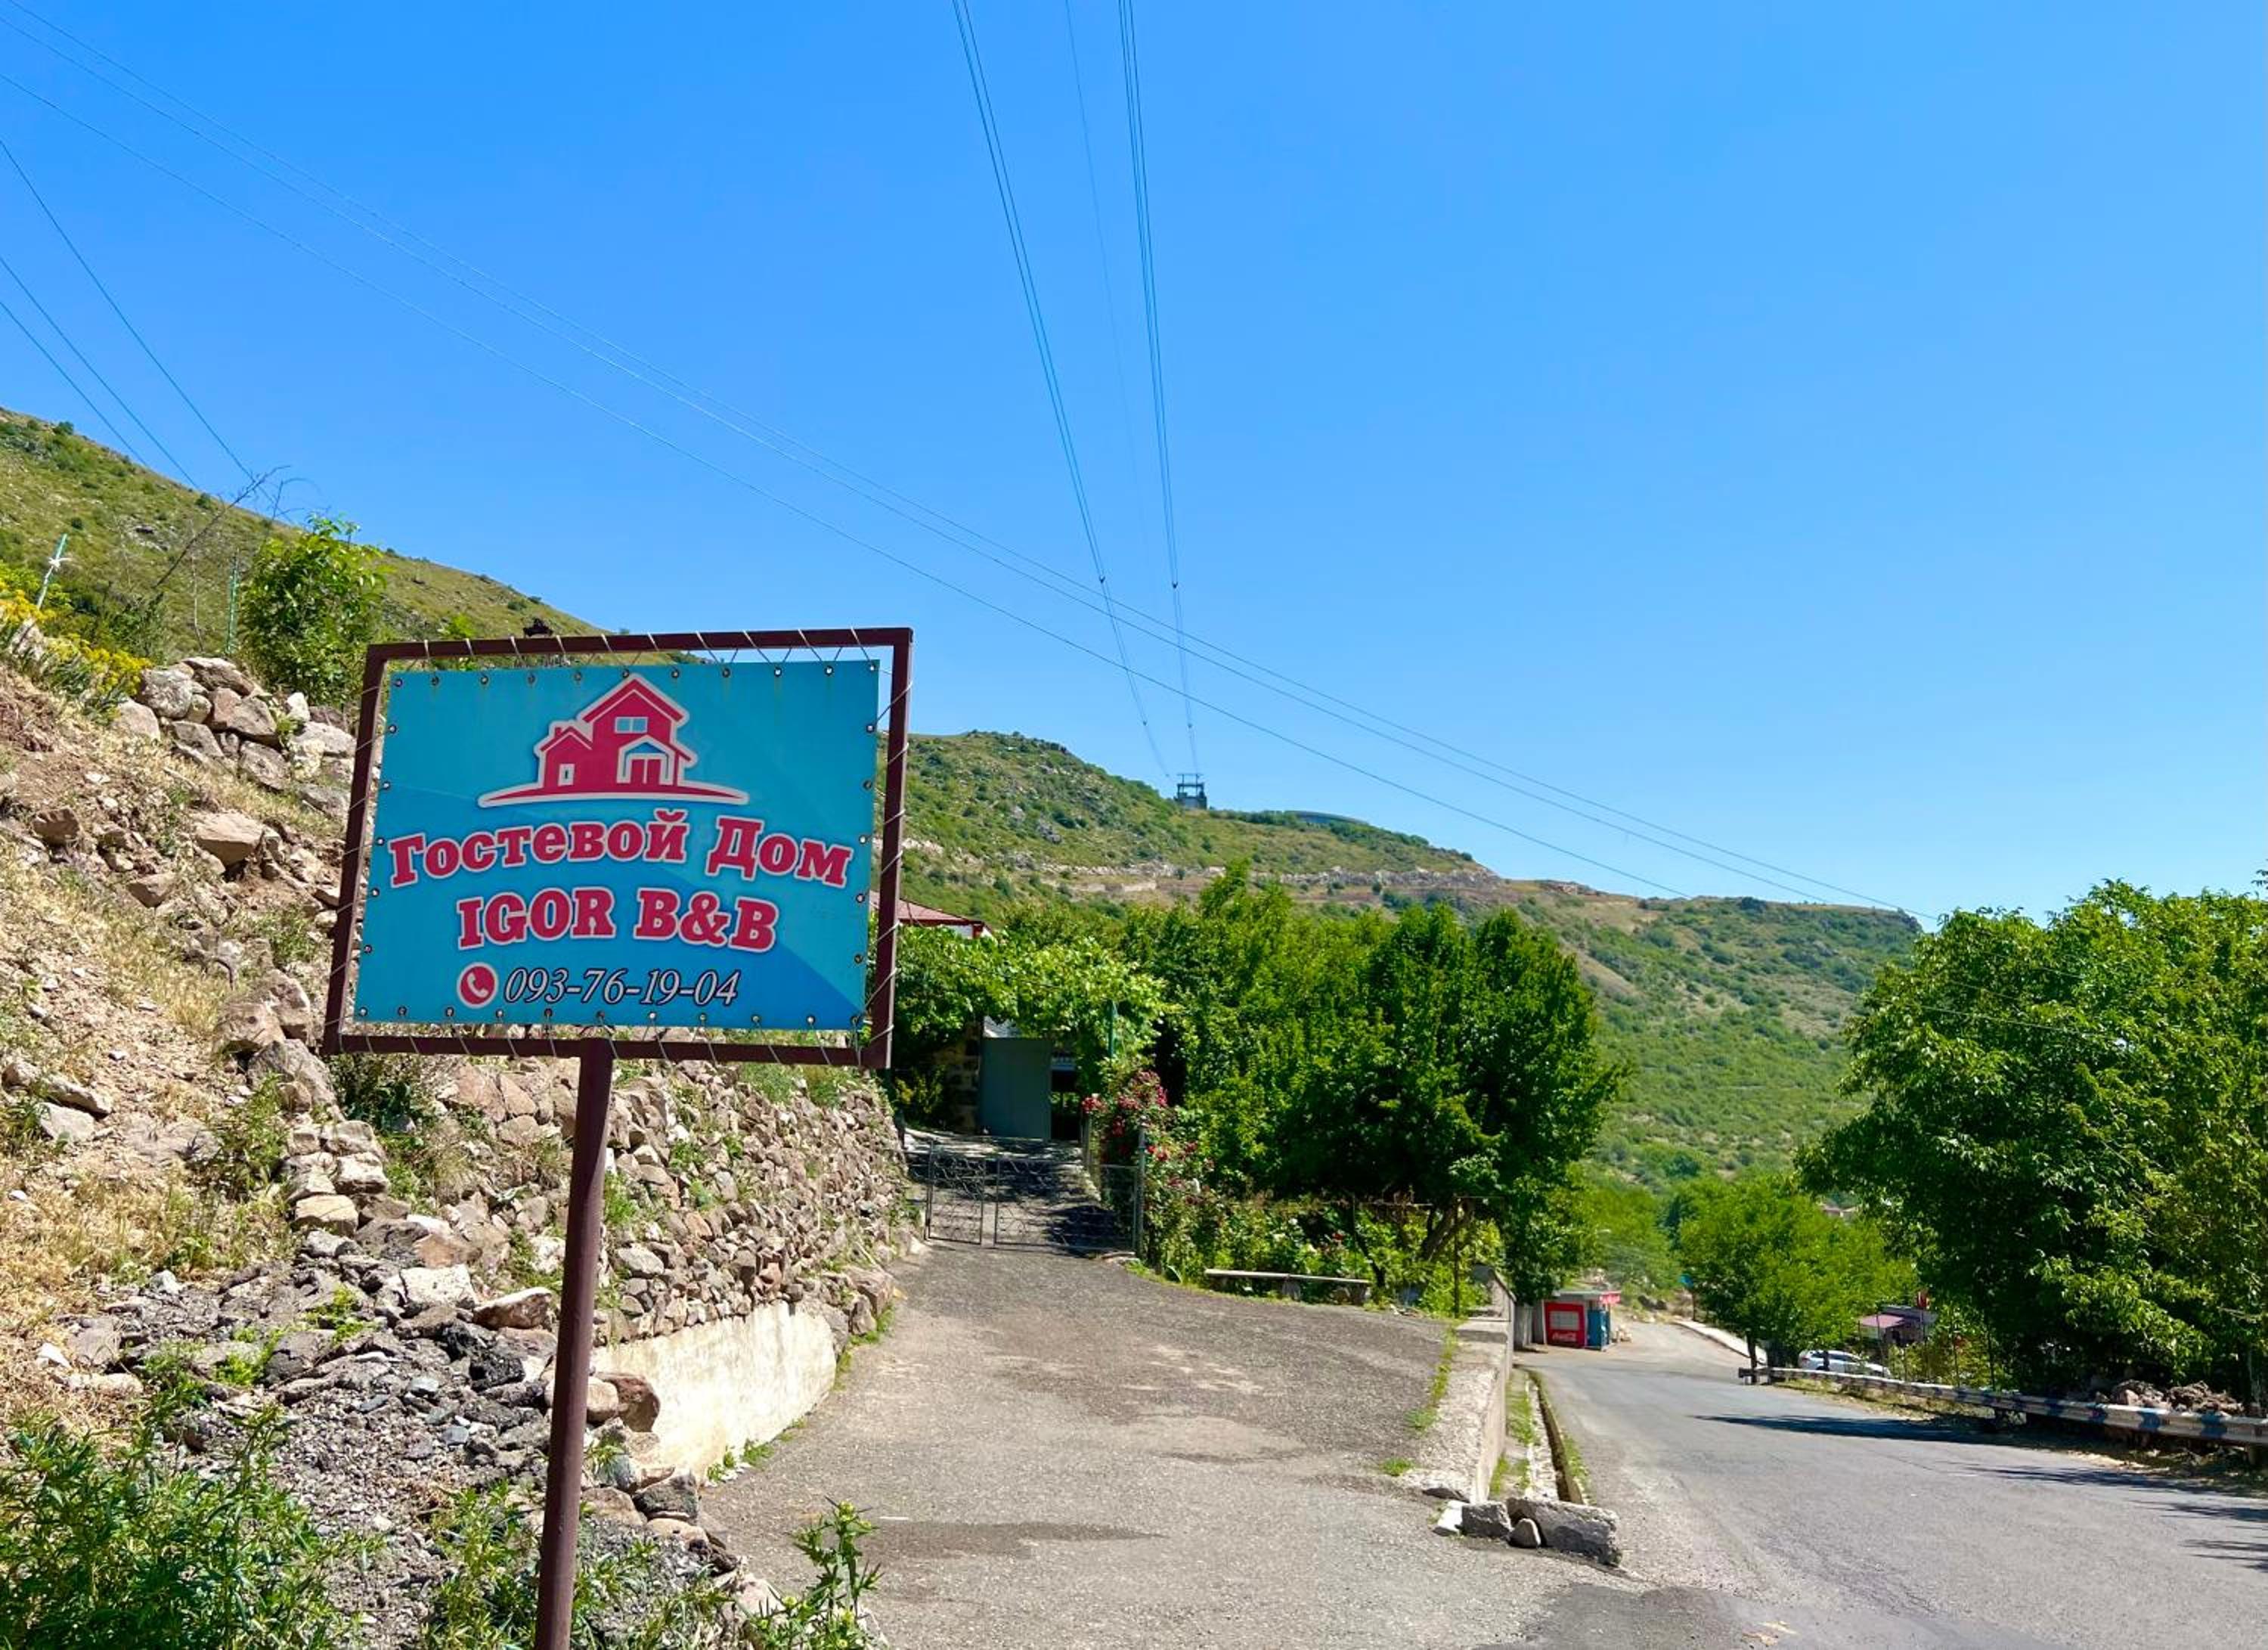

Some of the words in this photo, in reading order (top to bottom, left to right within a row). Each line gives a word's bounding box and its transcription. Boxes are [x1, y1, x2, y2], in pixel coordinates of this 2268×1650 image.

[389, 808, 689, 886] Гостевой
[706, 816, 853, 886] Дом
[457, 888, 615, 948] IGOR
[634, 888, 779, 952] B&B
[504, 968, 740, 1006] 093-76-19-04
